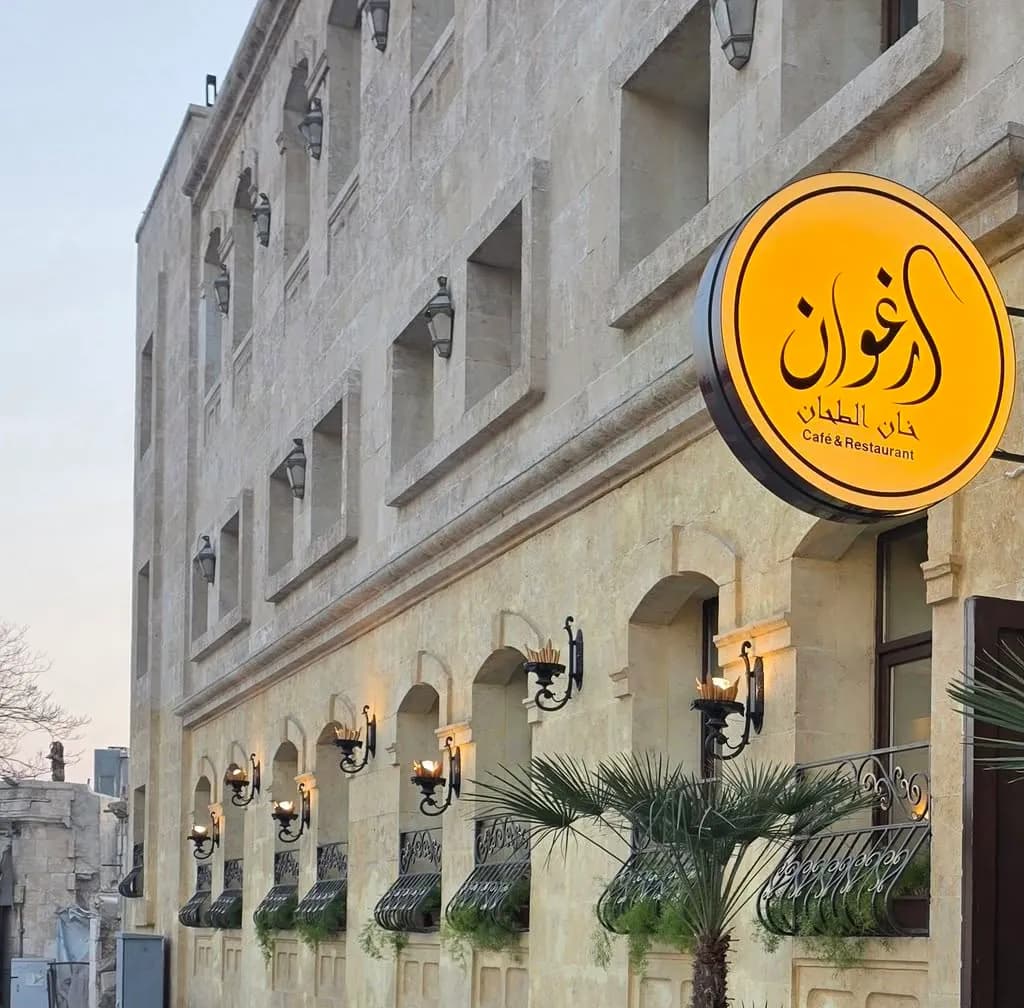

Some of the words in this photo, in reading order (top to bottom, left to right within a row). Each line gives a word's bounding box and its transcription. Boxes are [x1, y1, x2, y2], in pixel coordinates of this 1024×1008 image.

[796, 395, 869, 428] الطحان
[876, 411, 920, 441] خان
[845, 436, 914, 461] Restaurant
